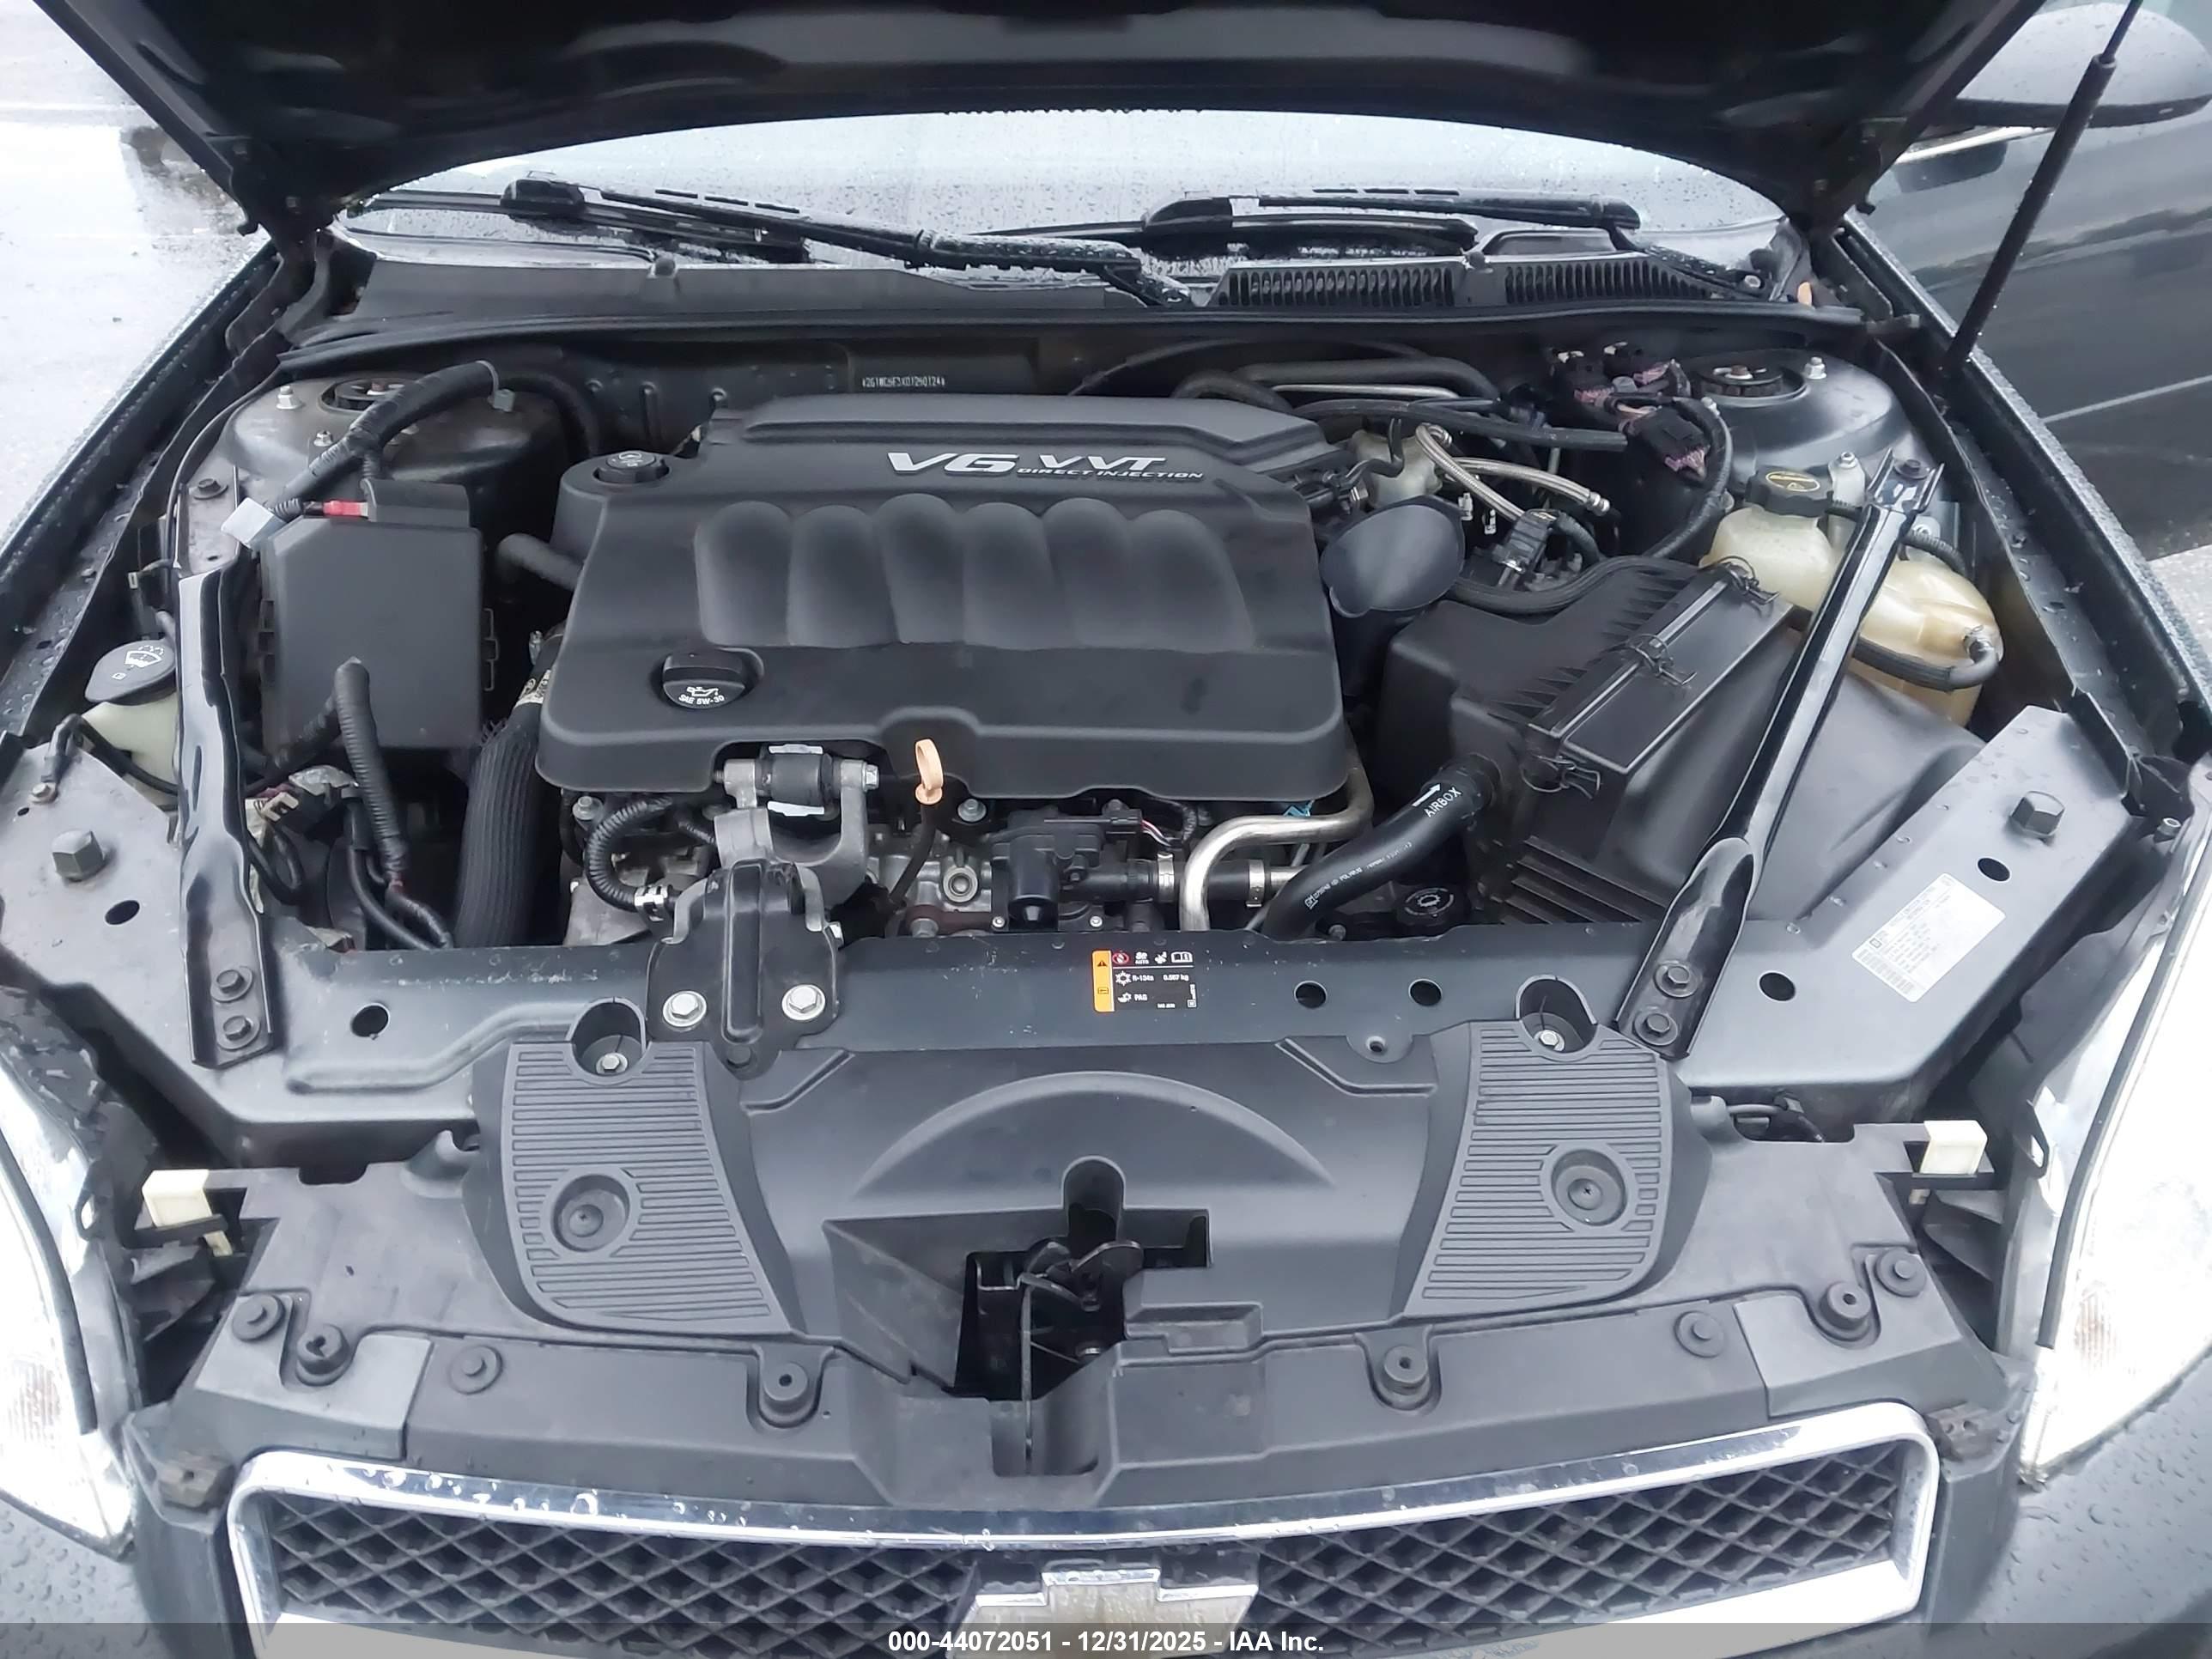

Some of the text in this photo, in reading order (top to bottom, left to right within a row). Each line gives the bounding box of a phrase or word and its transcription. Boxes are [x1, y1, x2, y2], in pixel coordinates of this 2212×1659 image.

[887, 453, 1166, 473] V6 VVT
[1017, 467, 1204, 479] DIRECT INJECTION
[678, 694, 724, 704] SAE 5W-30
[1424, 787, 1462, 817] AIRBOX
